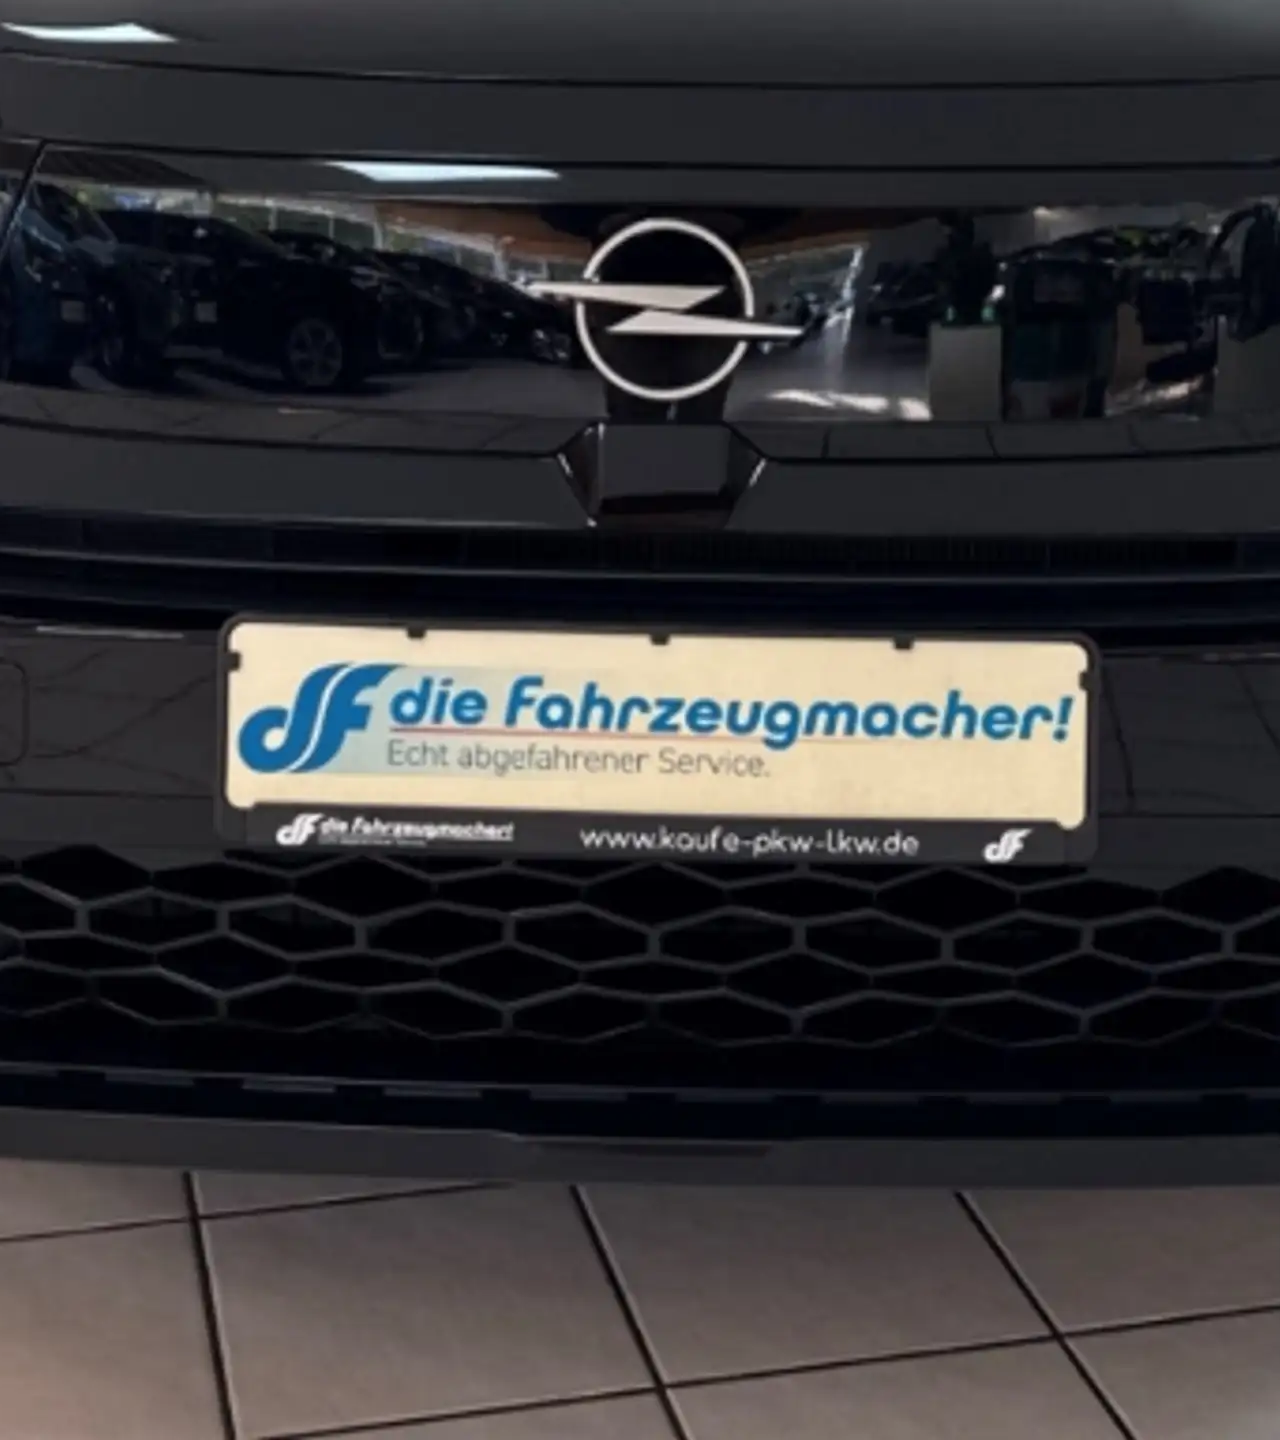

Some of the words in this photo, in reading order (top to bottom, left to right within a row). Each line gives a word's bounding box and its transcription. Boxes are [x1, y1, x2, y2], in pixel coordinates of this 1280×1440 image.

[390, 676, 488, 725] die
[505, 675, 1074, 750] Fahrzeugmacher!
[387, 738, 450, 768] Echt
[457, 741, 651, 777] abgefahrener
[658, 747, 771, 778] Service.
